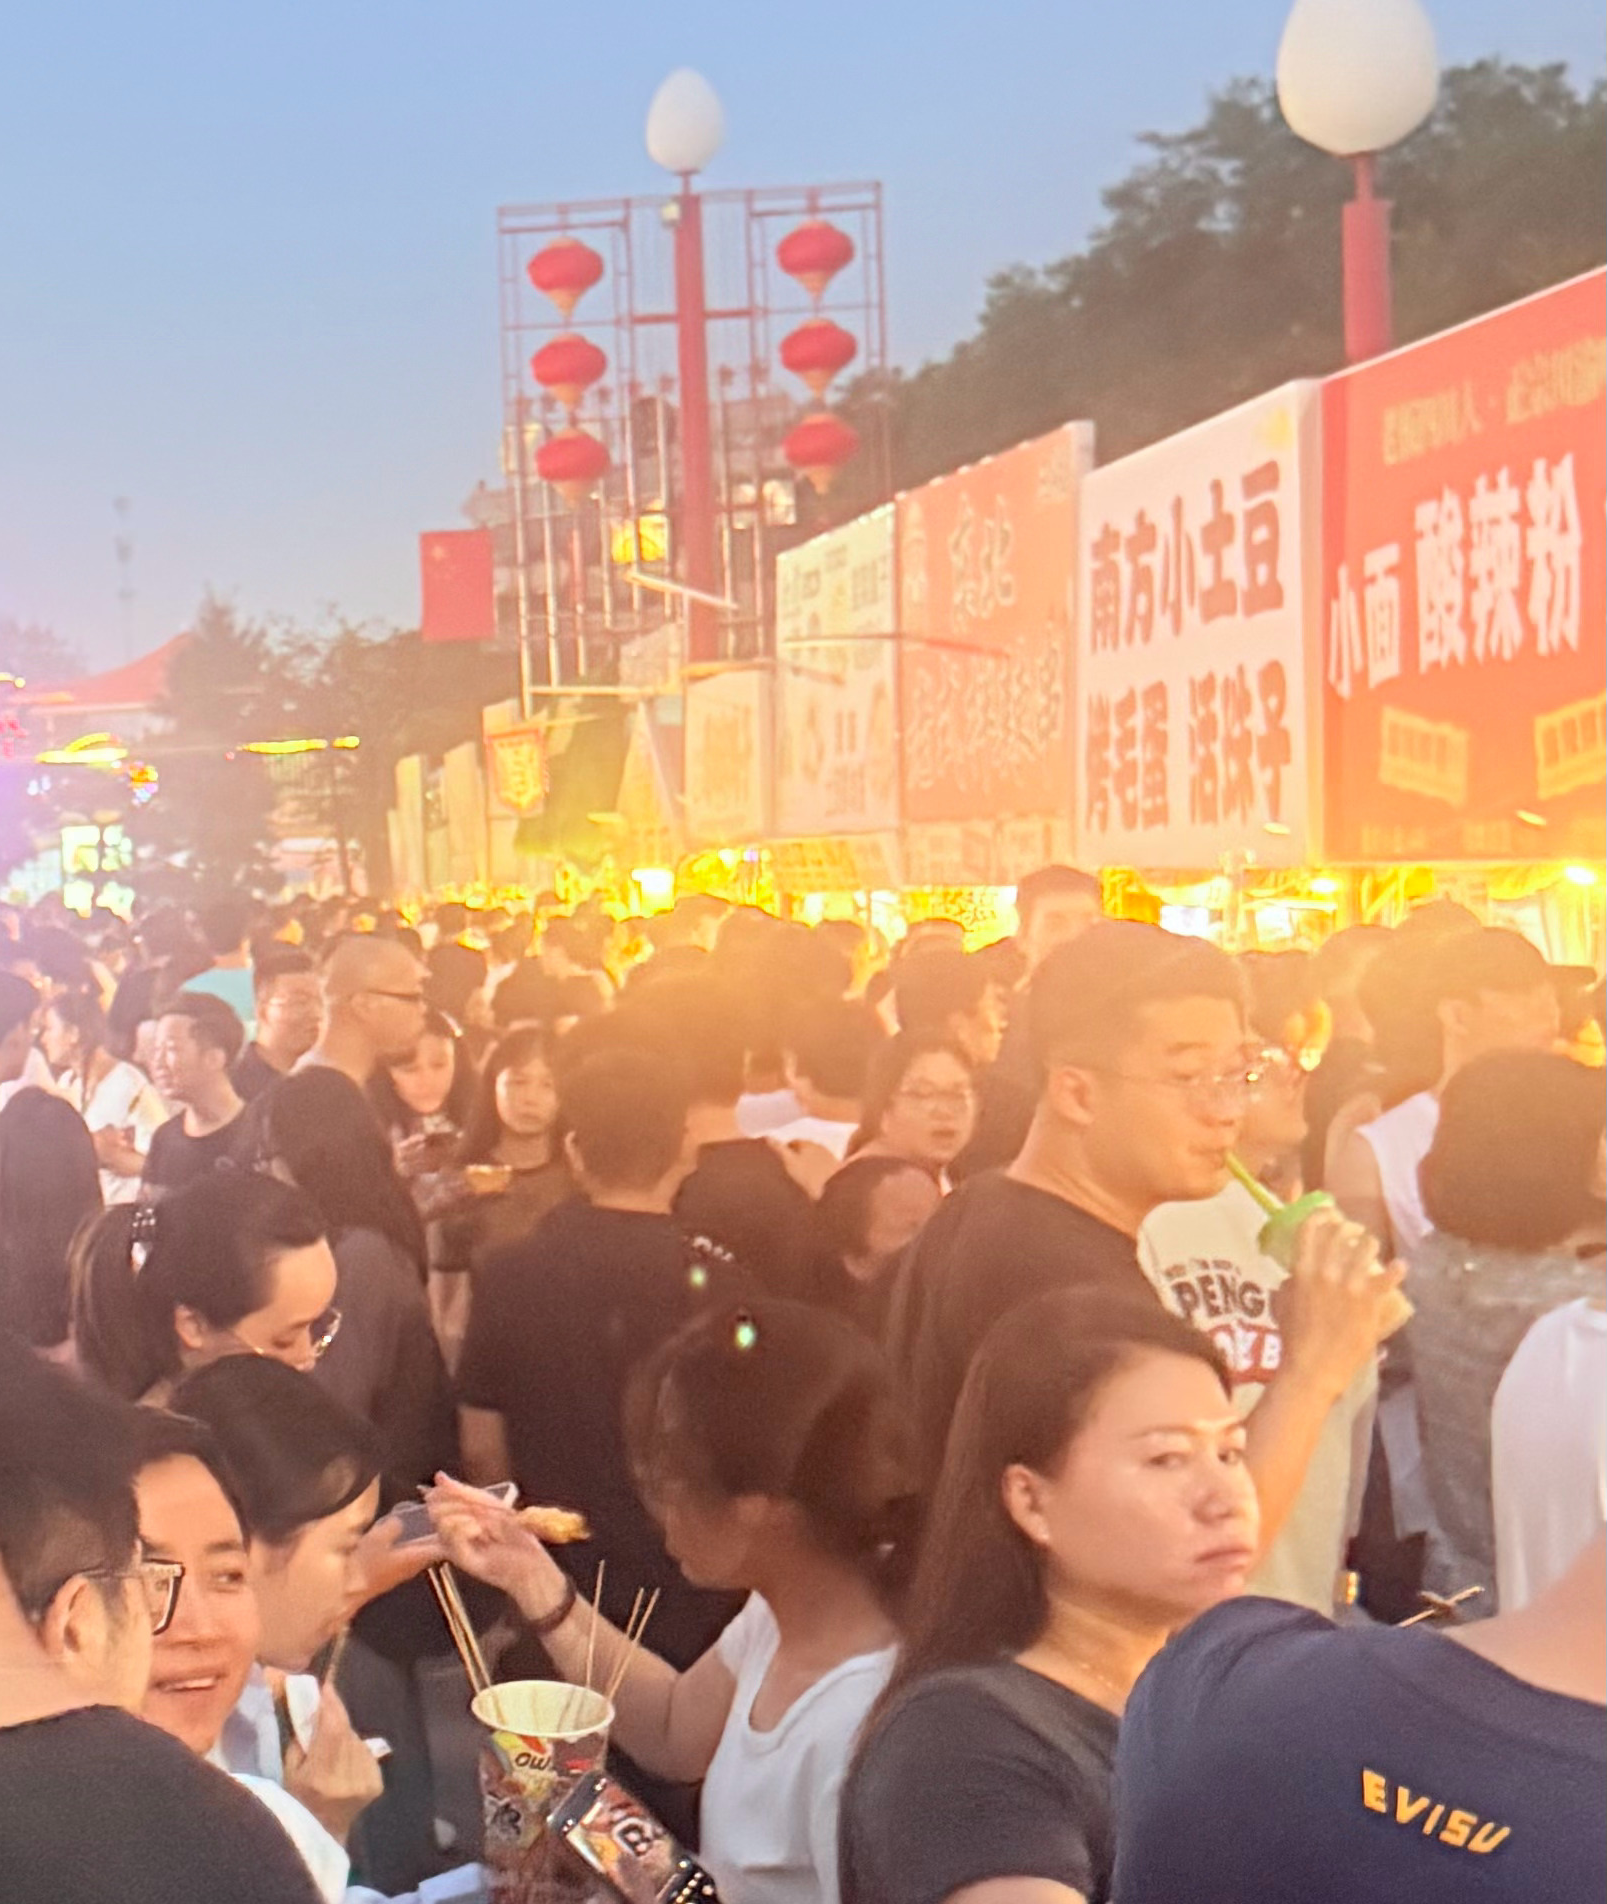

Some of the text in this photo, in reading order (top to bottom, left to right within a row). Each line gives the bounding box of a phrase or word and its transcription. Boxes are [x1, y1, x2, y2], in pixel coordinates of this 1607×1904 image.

[1090, 458, 1284, 655] 南方小土豆
[1327, 449, 1583, 700] 小面 酸辣粉
[1188, 659, 1292, 827] 活珠子
[1361, 1767, 1512, 1854] EVISU
